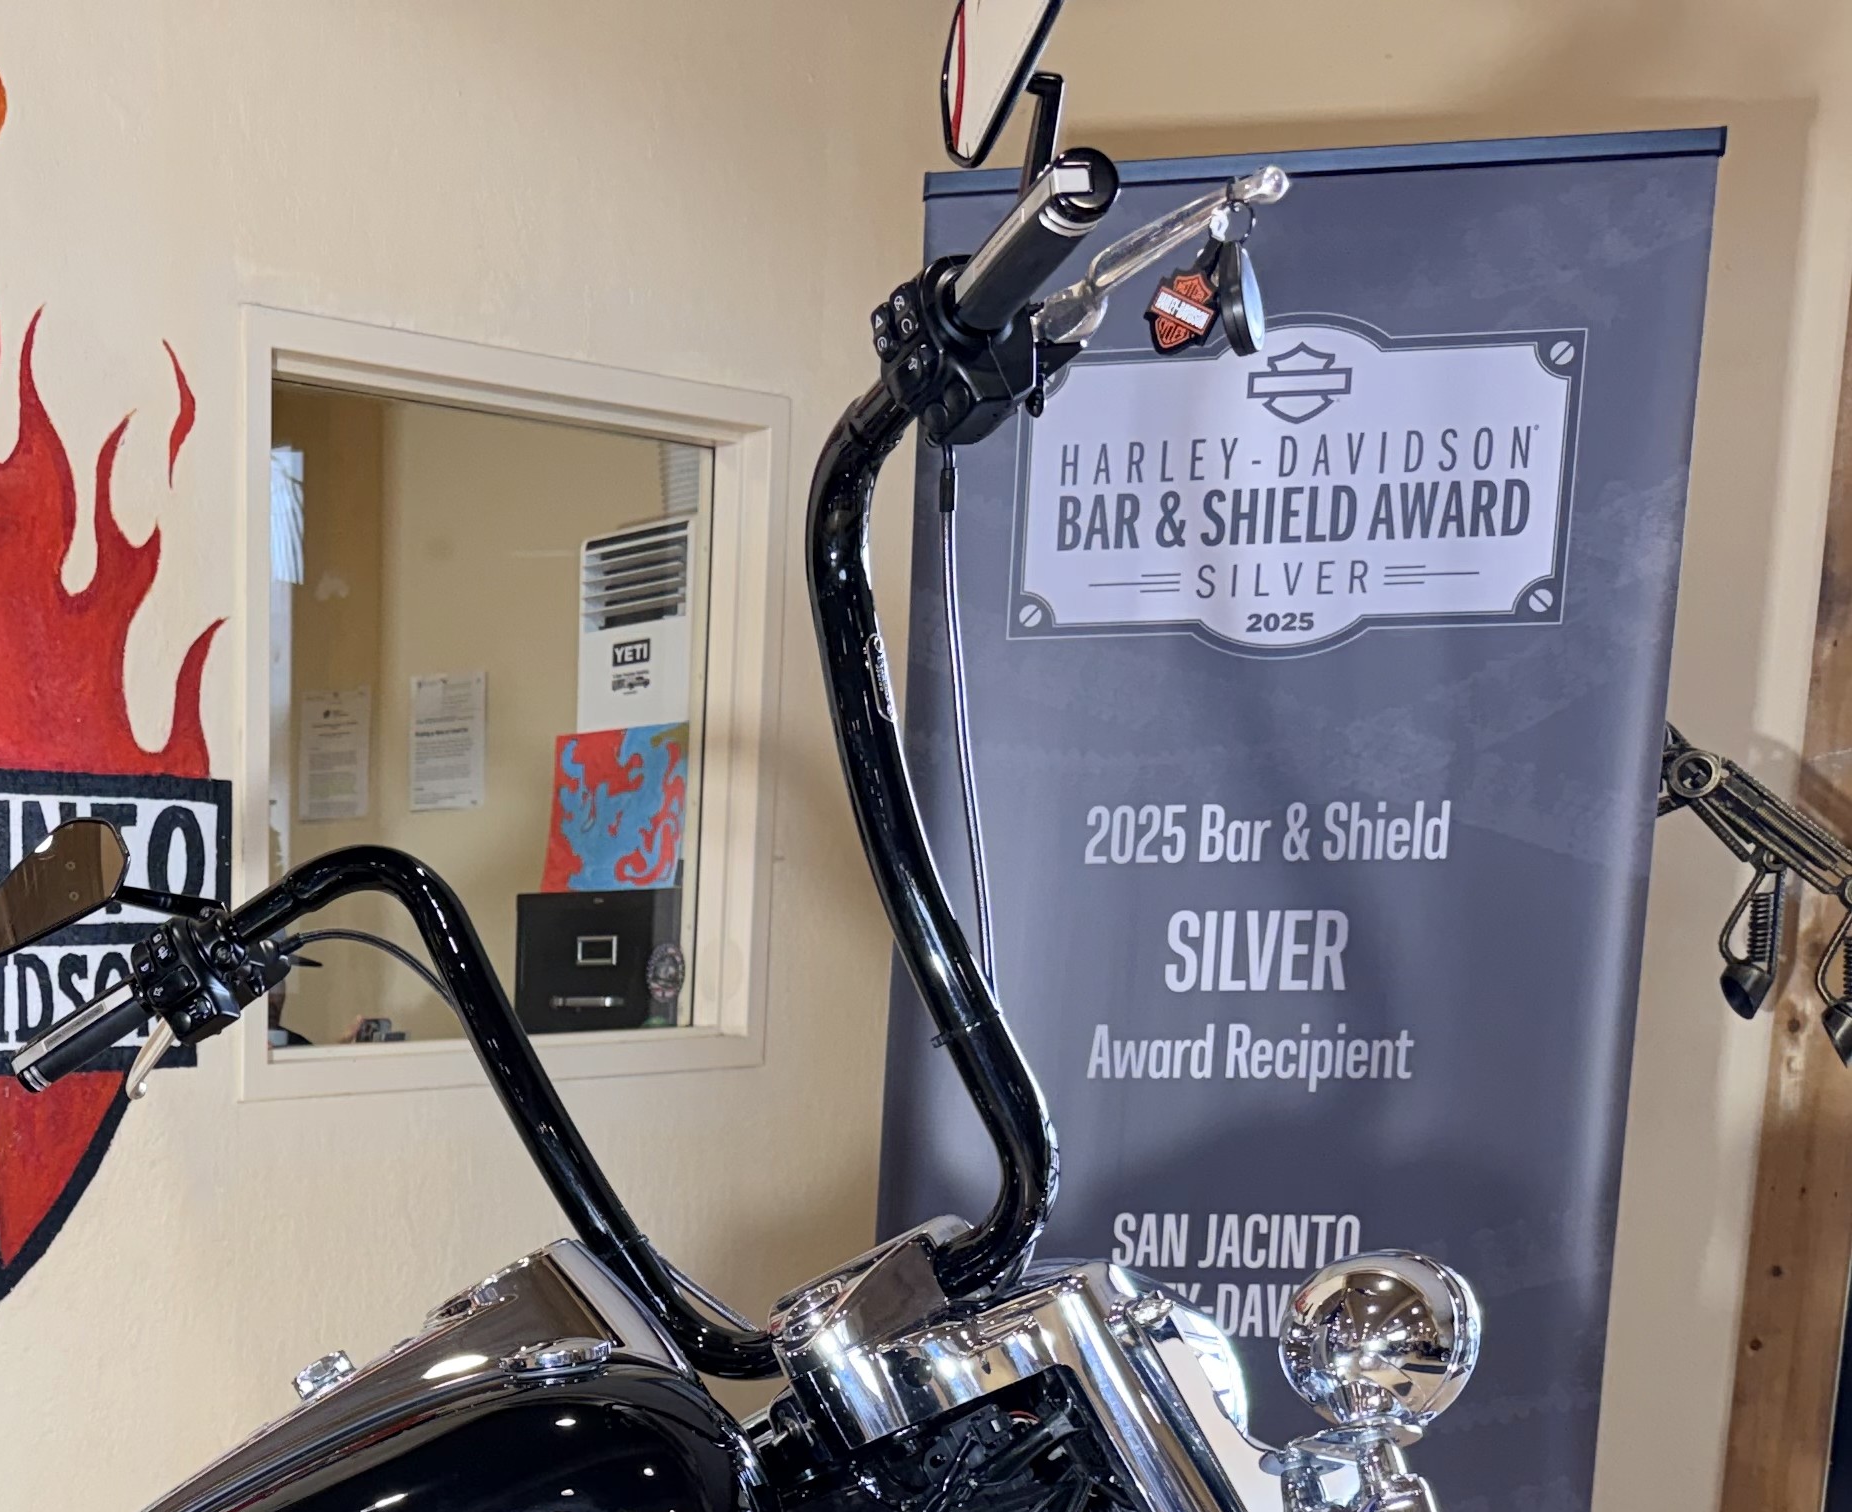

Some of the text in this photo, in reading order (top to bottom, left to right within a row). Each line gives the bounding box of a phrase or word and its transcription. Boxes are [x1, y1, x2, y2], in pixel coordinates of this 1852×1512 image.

[1056, 478, 1530, 551] BAR & SHIELD AWARD
[1195, 559, 1370, 599] SILVER
[1246, 611, 1315, 633] 2025
[614, 643, 648, 664] YETI
[1084, 800, 1451, 865] 2025 Bar & Shield
[1164, 909, 1349, 993] SILVER
[1086, 1023, 1415, 1093] Award Recipient
[1112, 1212, 1361, 1269] SAN JACINTO
